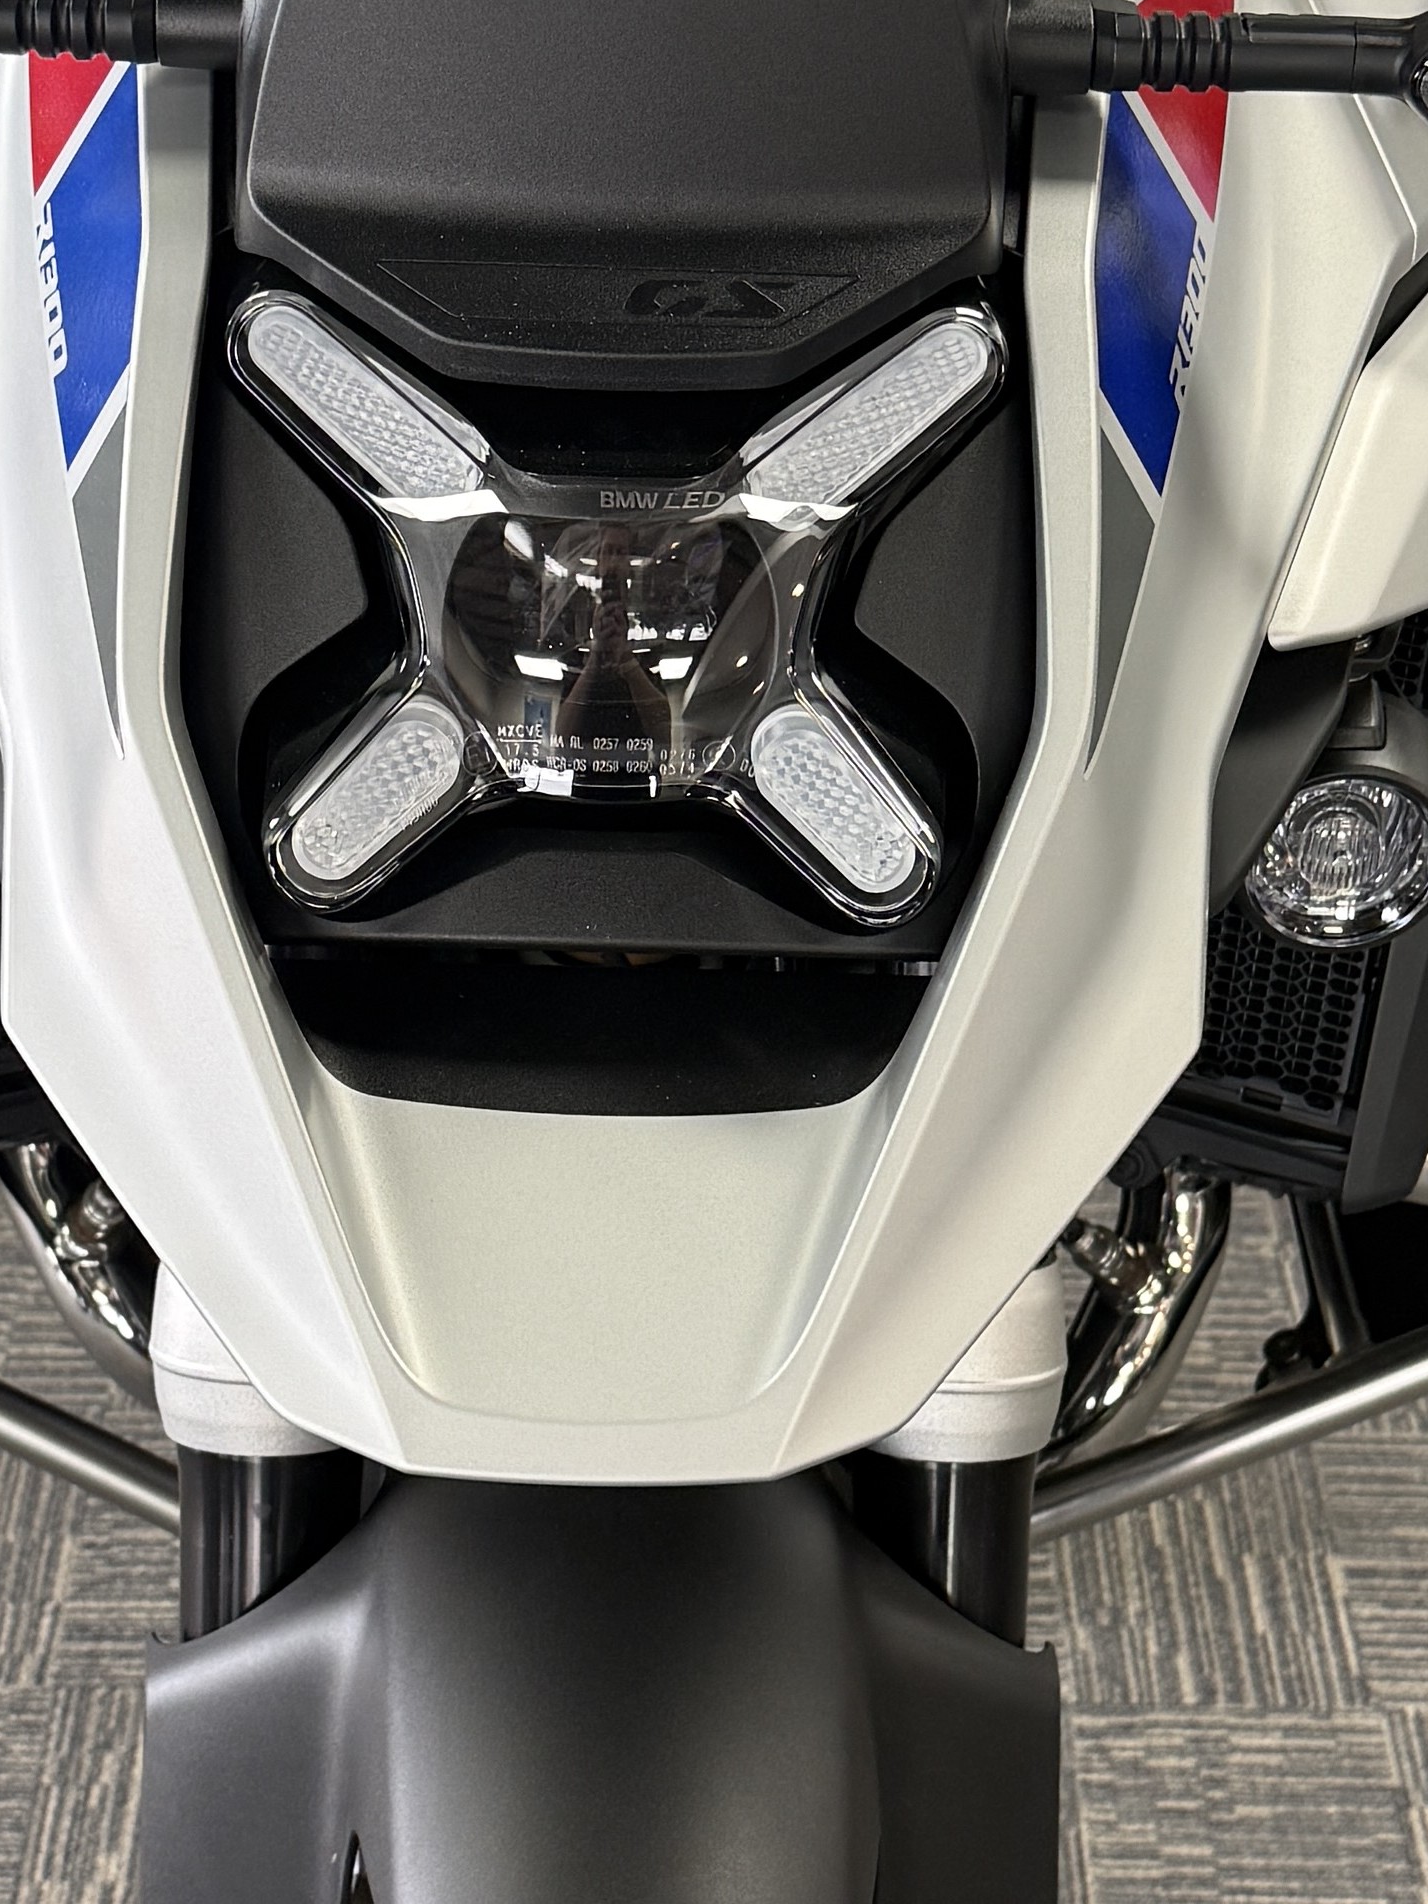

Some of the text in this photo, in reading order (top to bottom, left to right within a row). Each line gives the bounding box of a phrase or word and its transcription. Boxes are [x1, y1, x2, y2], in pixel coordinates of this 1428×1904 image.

[623, 278, 798, 319] GS
[600, 490, 726, 509] BMW LED
[593, 737, 619, 751] 0257
